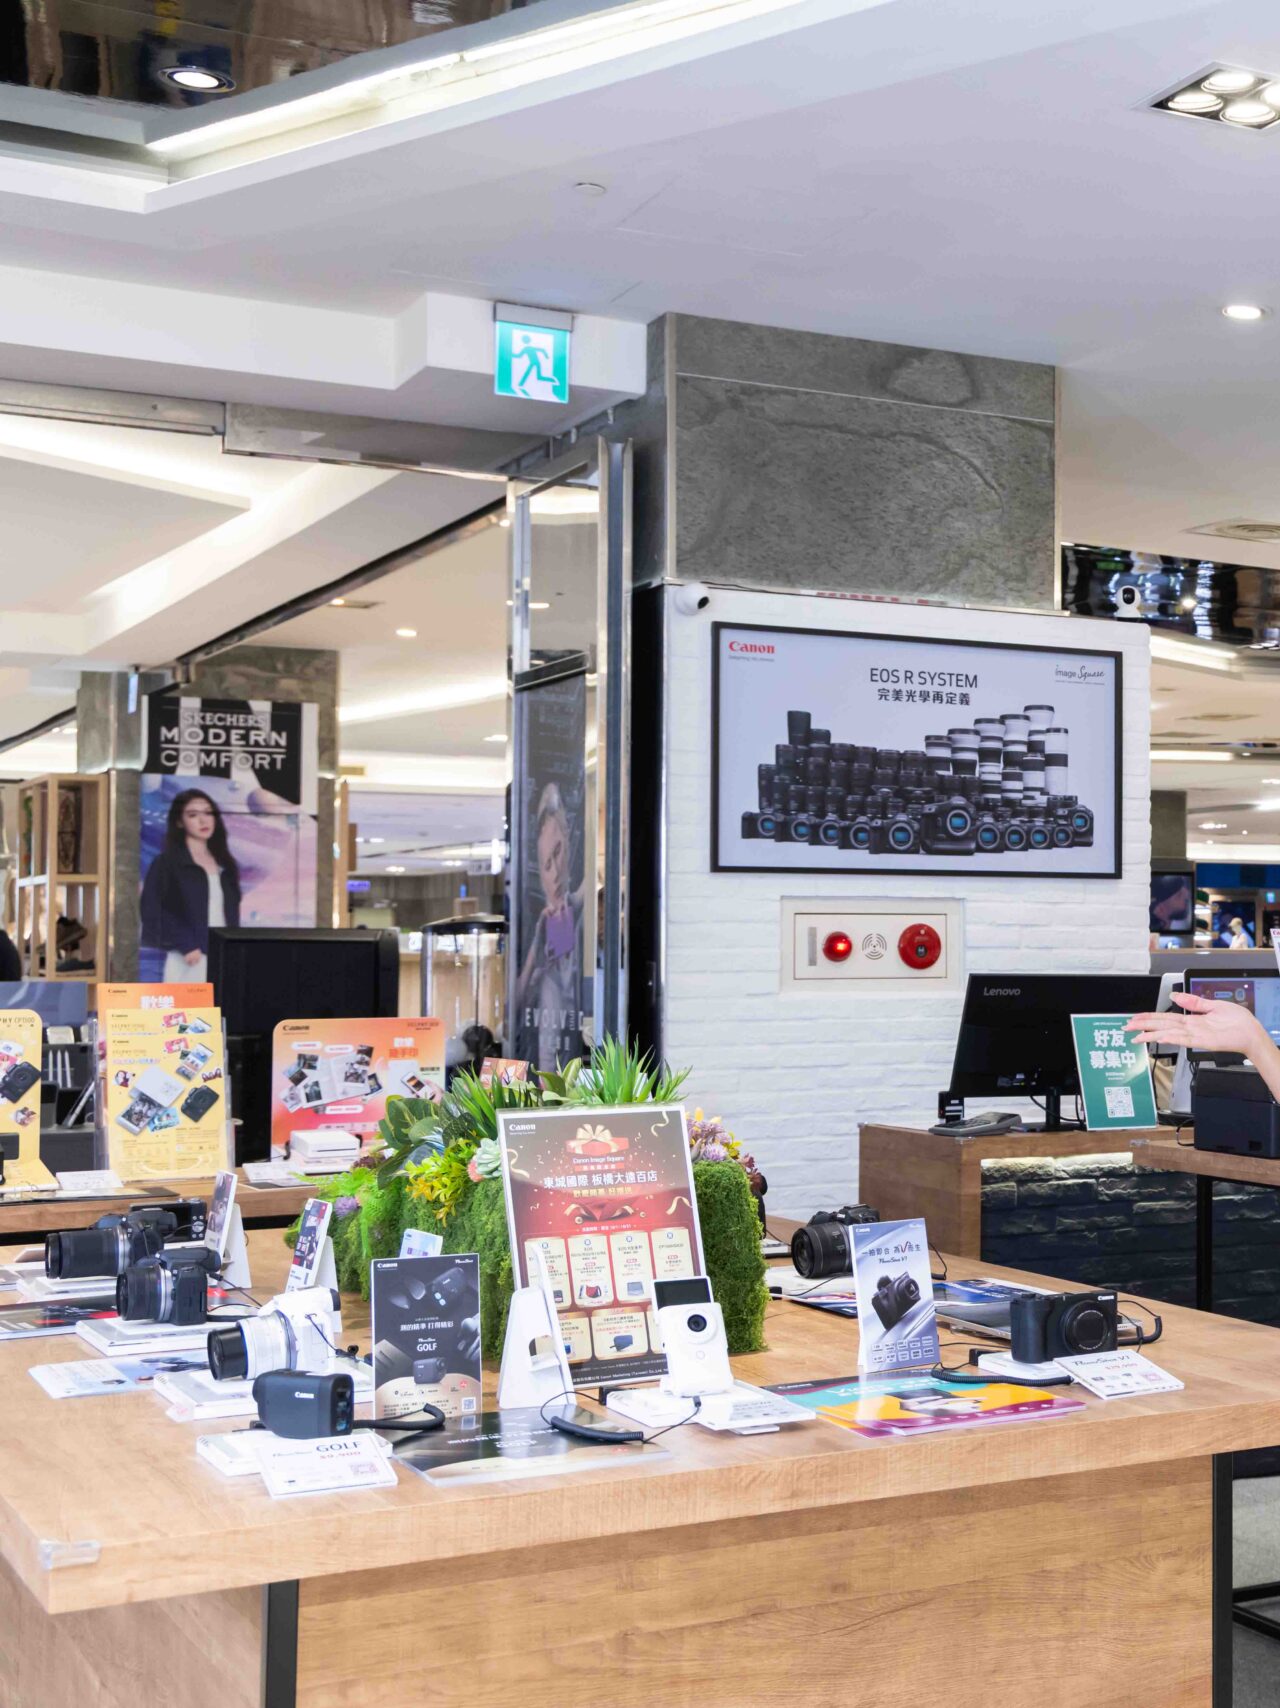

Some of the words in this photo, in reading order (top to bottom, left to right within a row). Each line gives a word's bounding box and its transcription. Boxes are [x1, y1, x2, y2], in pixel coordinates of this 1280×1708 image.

[728, 640, 775, 654] Canon
[870, 668, 900, 684] EOS
[904, 670, 914, 685] R
[918, 671, 978, 689] SYSTEM
[877, 688, 970, 706] 完美光學再定義
[182, 712, 267, 728] SKECHERS
[160, 726, 287, 747] MODERN
[160, 750, 287, 771] COMFORT
[983, 987, 1021, 997] Lenovo
[1093, 1029, 1127, 1048] 好友
[1089, 1050, 1137, 1070] 募集中
[508, 1123, 536, 1132] Canon
[543, 1174, 589, 1189] 東城國際
[592, 1170, 658, 1187] 板橋大遠百店
[416, 1343, 438, 1352] GOLF
[294, 1391, 315, 1399] Canon
[316, 1441, 362, 1452] GOLF
